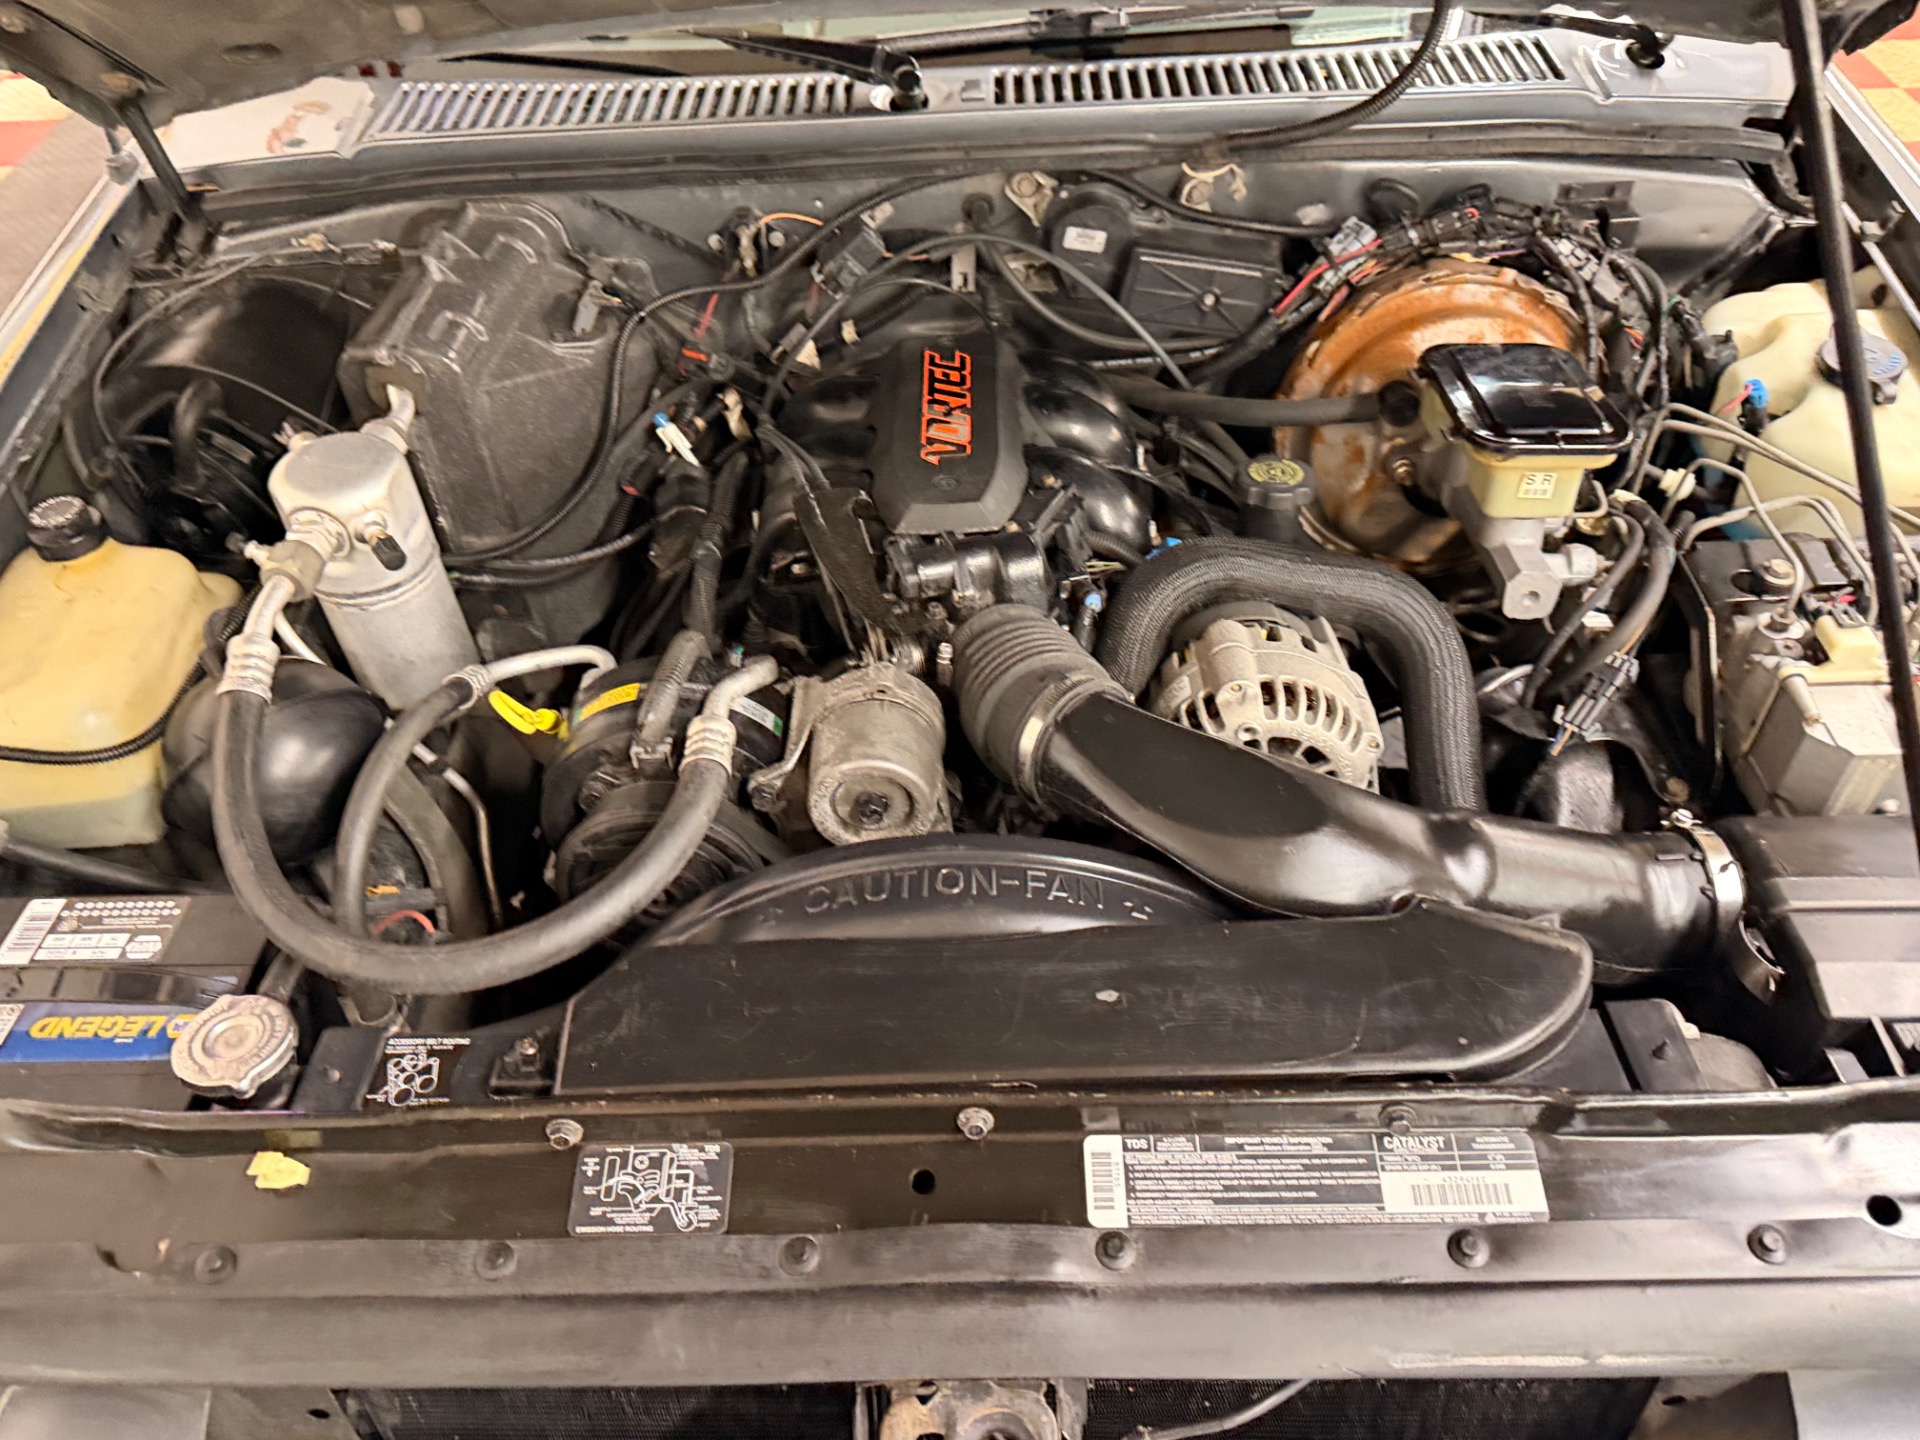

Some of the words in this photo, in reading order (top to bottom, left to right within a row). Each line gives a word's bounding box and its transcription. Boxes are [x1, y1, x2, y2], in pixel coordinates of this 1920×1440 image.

[920, 348, 972, 465] VORTEC
[29, 1015, 169, 1039] LEGEND
[1125, 1138, 1149, 1150] TDS
[1382, 1136, 1446, 1150] CATALYST
